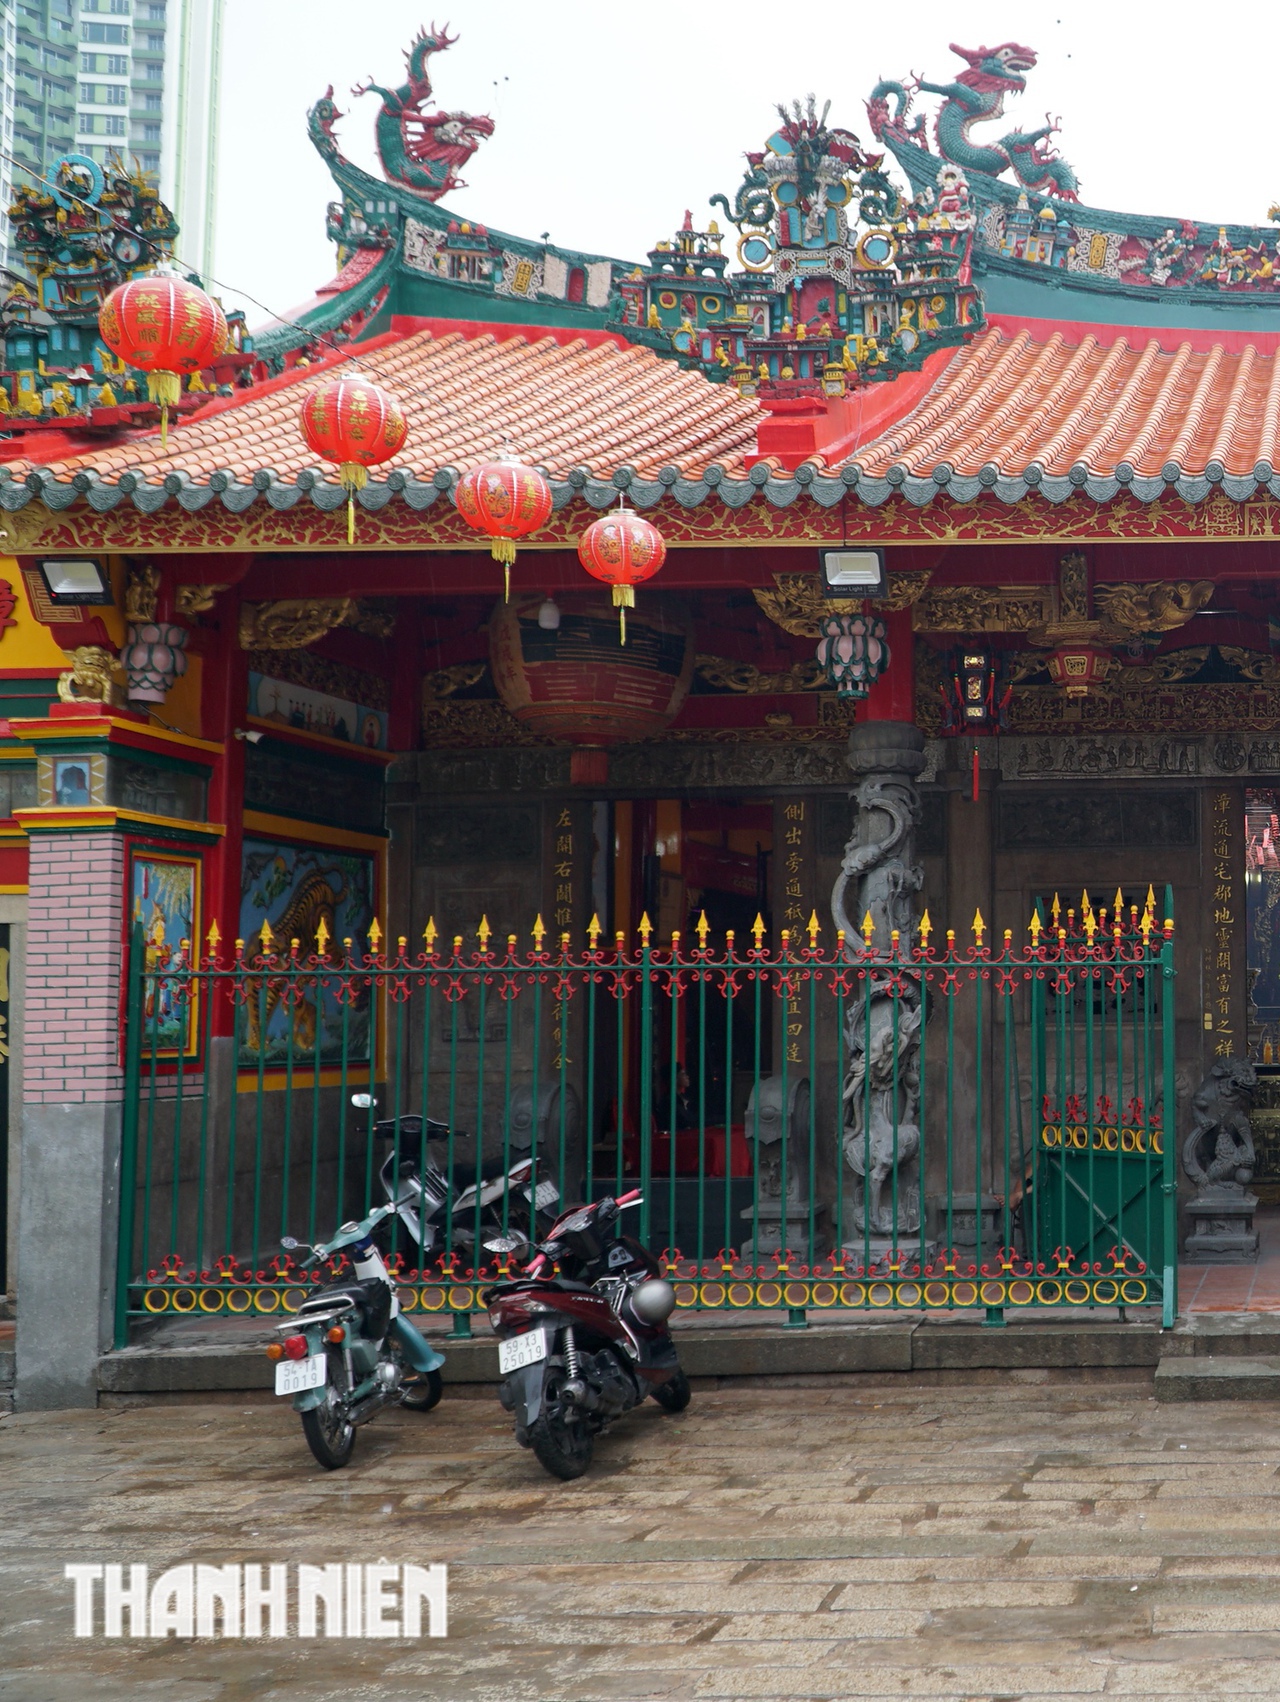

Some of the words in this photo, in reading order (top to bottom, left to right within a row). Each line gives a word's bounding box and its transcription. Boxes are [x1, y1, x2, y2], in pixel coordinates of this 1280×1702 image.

[506, 1333, 537, 1355] 59-X3
[283, 1358, 317, 1377] 54-TA
[503, 1345, 542, 1371] 250.19
[283, 1372, 317, 1390] 0019
